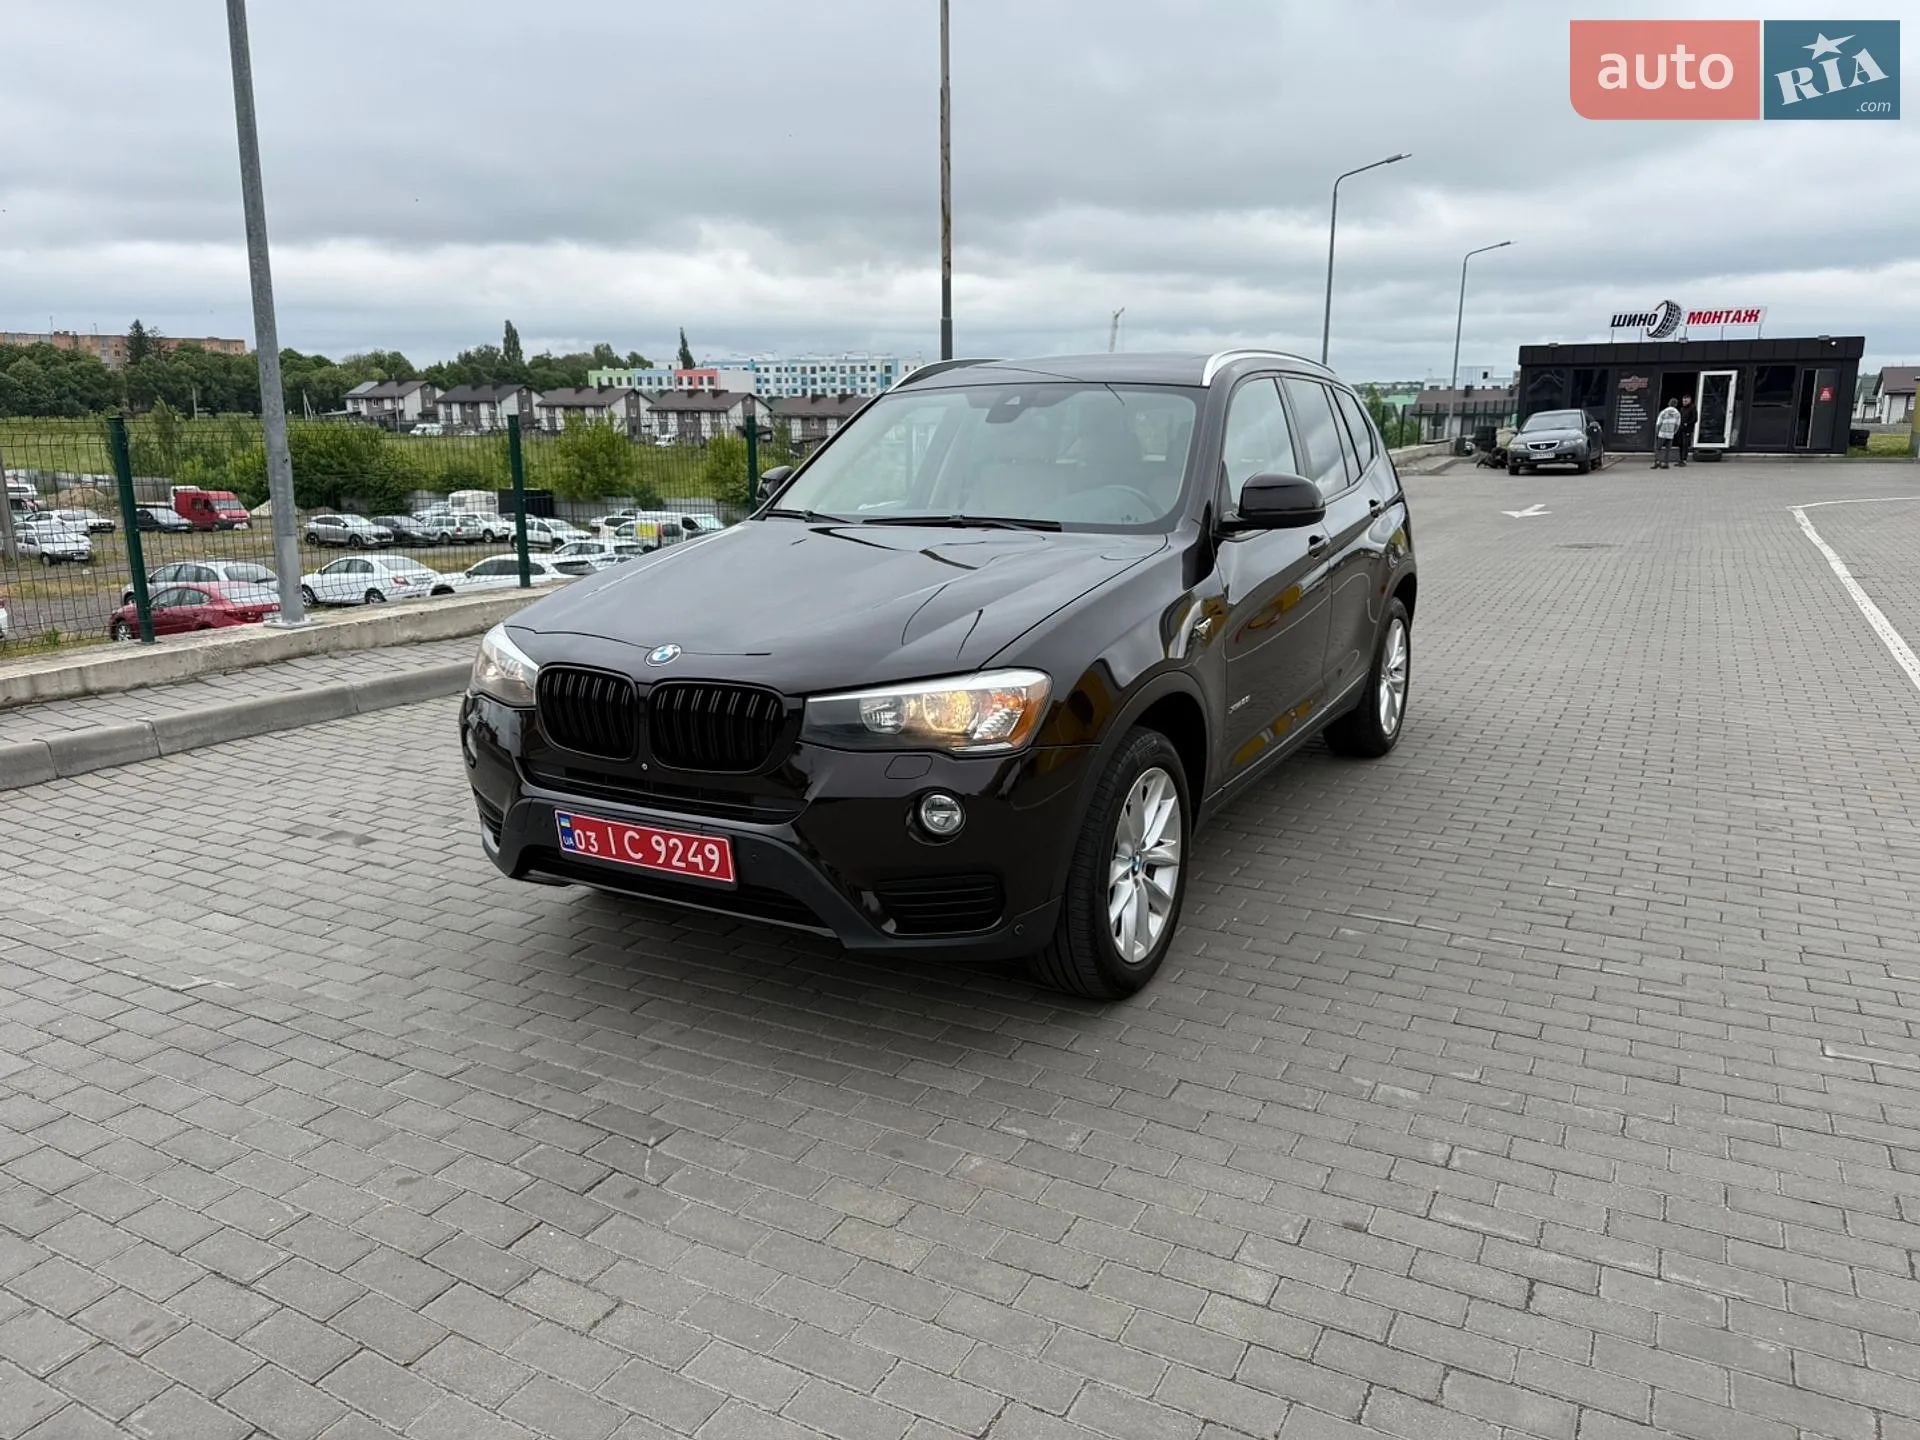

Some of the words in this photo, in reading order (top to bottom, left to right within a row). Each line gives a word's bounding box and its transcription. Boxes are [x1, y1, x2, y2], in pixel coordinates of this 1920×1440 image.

[1611, 313, 1658, 328] ШИНО
[1687, 309, 1761, 325] МОНТАЖ
[563, 836, 575, 847] UA
[574, 829, 598, 853] 03
[651, 835, 720, 873] 9249
